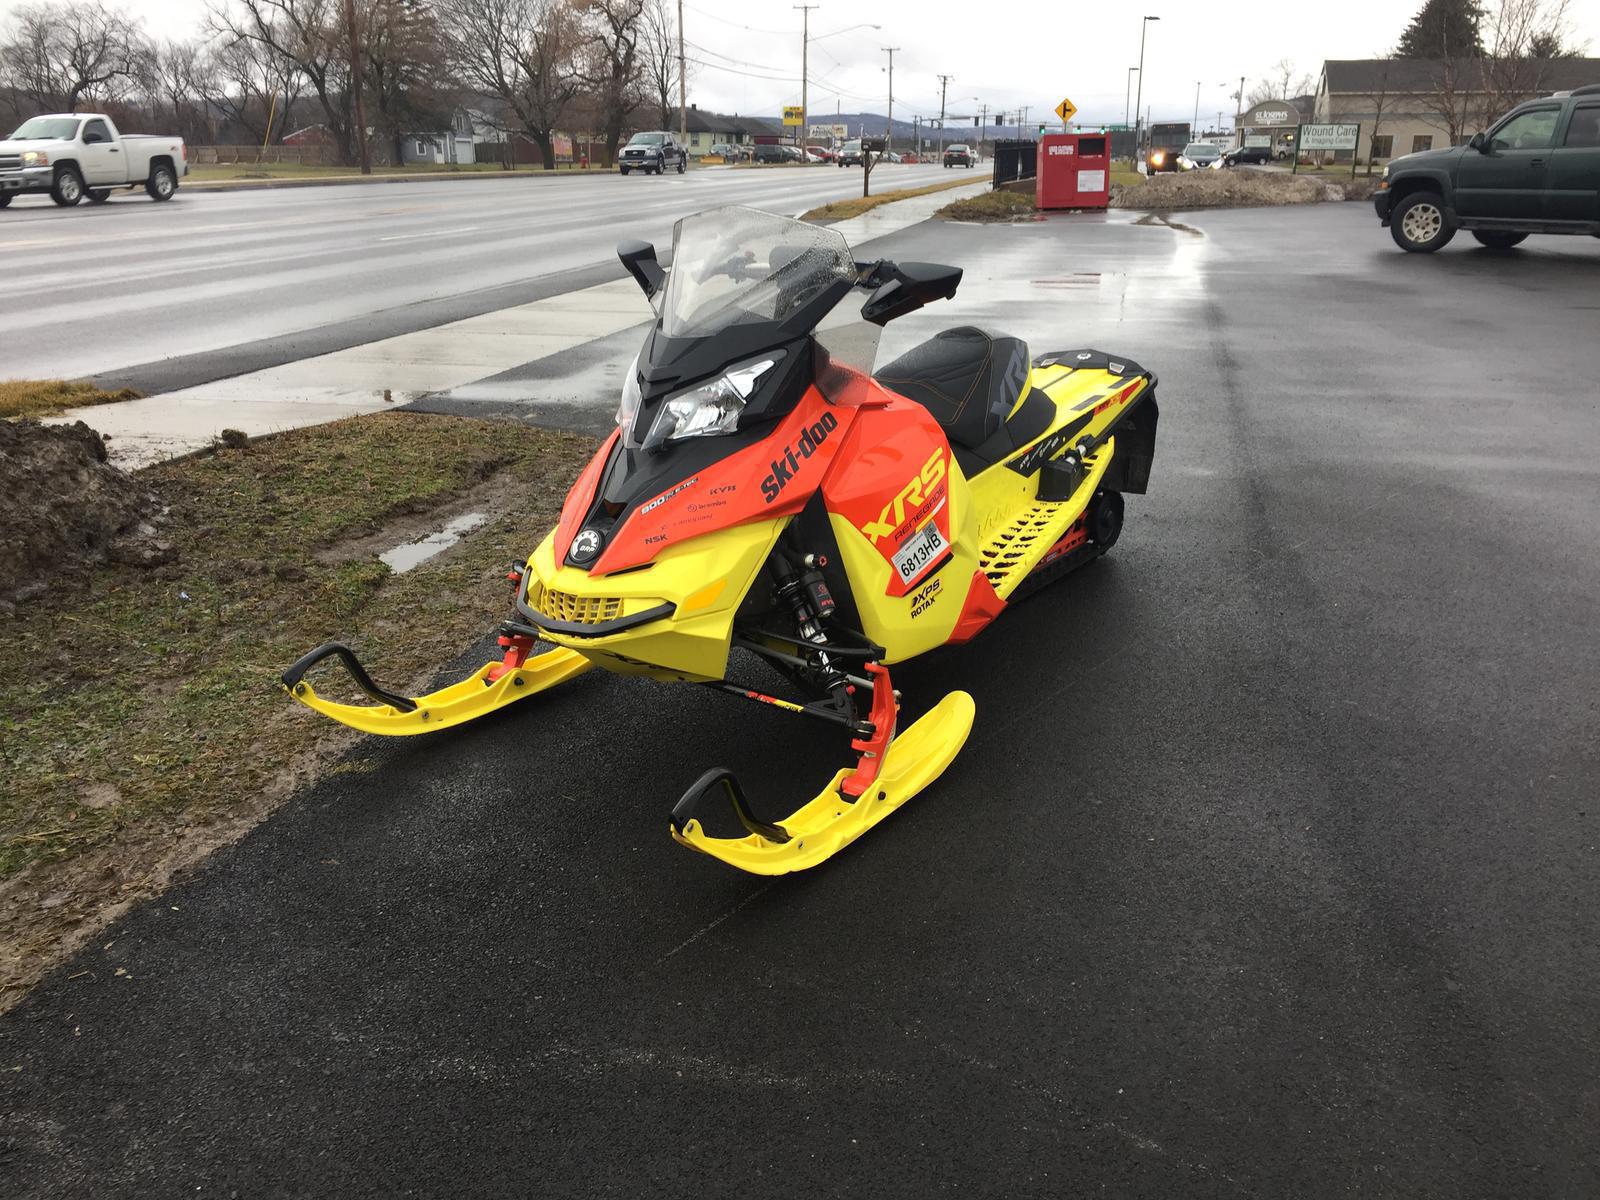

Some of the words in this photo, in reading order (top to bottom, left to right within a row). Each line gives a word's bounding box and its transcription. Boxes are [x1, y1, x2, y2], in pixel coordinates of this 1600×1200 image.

[1303, 126, 1333, 137] Wound
[1336, 126, 1357, 137] Care
[760, 411, 838, 504] ski-doo
[861, 447, 945, 544] XRS
[645, 533, 668, 545] NSK
[900, 533, 942, 577] 6813HB
[916, 579, 940, 604] XPS
[910, 595, 936, 619] ROTAX
